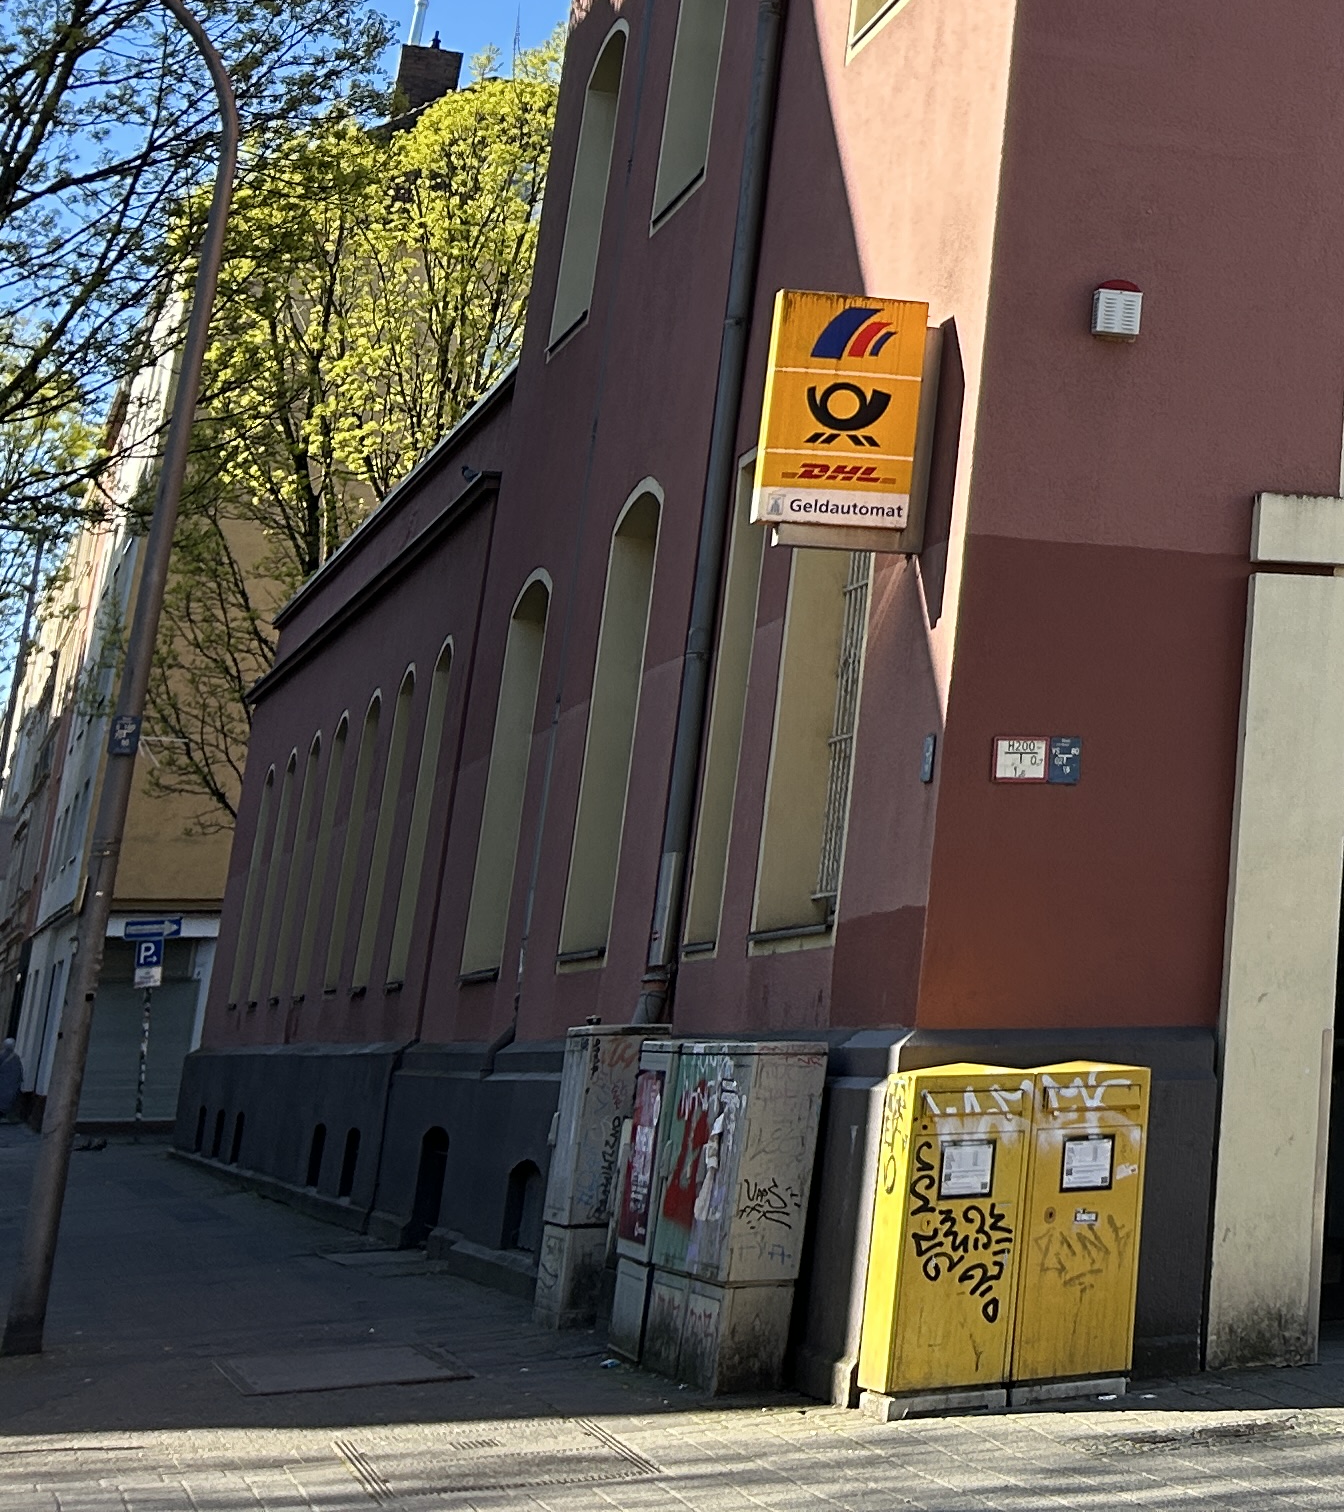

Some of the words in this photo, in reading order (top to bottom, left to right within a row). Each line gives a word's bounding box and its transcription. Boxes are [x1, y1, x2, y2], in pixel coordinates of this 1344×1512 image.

[797, 462, 881, 484] DHL
[789, 498, 904, 519] Geldautomat
[140, 942, 155, 964] P
